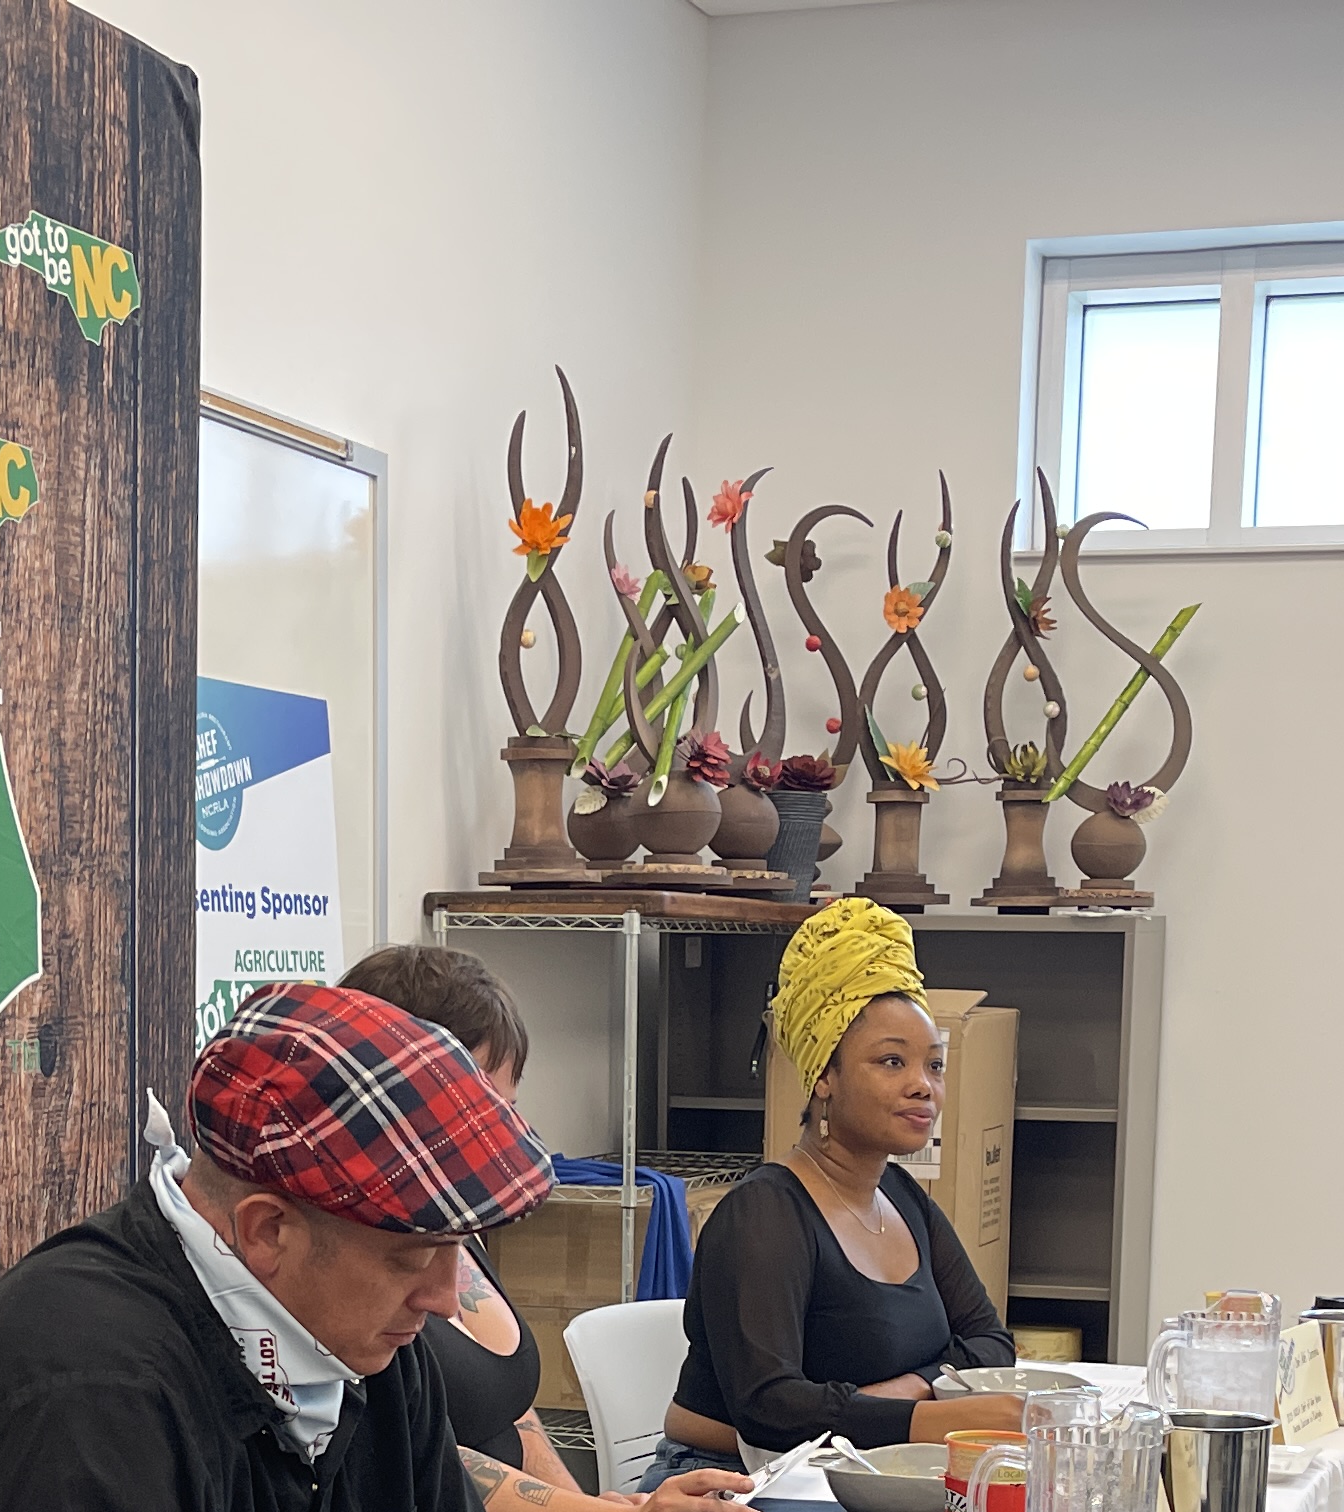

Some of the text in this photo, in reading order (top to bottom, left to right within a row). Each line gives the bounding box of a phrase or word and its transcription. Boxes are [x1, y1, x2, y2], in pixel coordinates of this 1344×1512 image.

[5, 218, 68, 265] got to
[44, 244, 133, 320] be NC
[196, 729, 218, 761] HEF
[196, 756, 253, 801] HOWDOWN
[261, 886, 328, 920] Sponsor
[235, 949, 326, 973] AGRICULTURE
